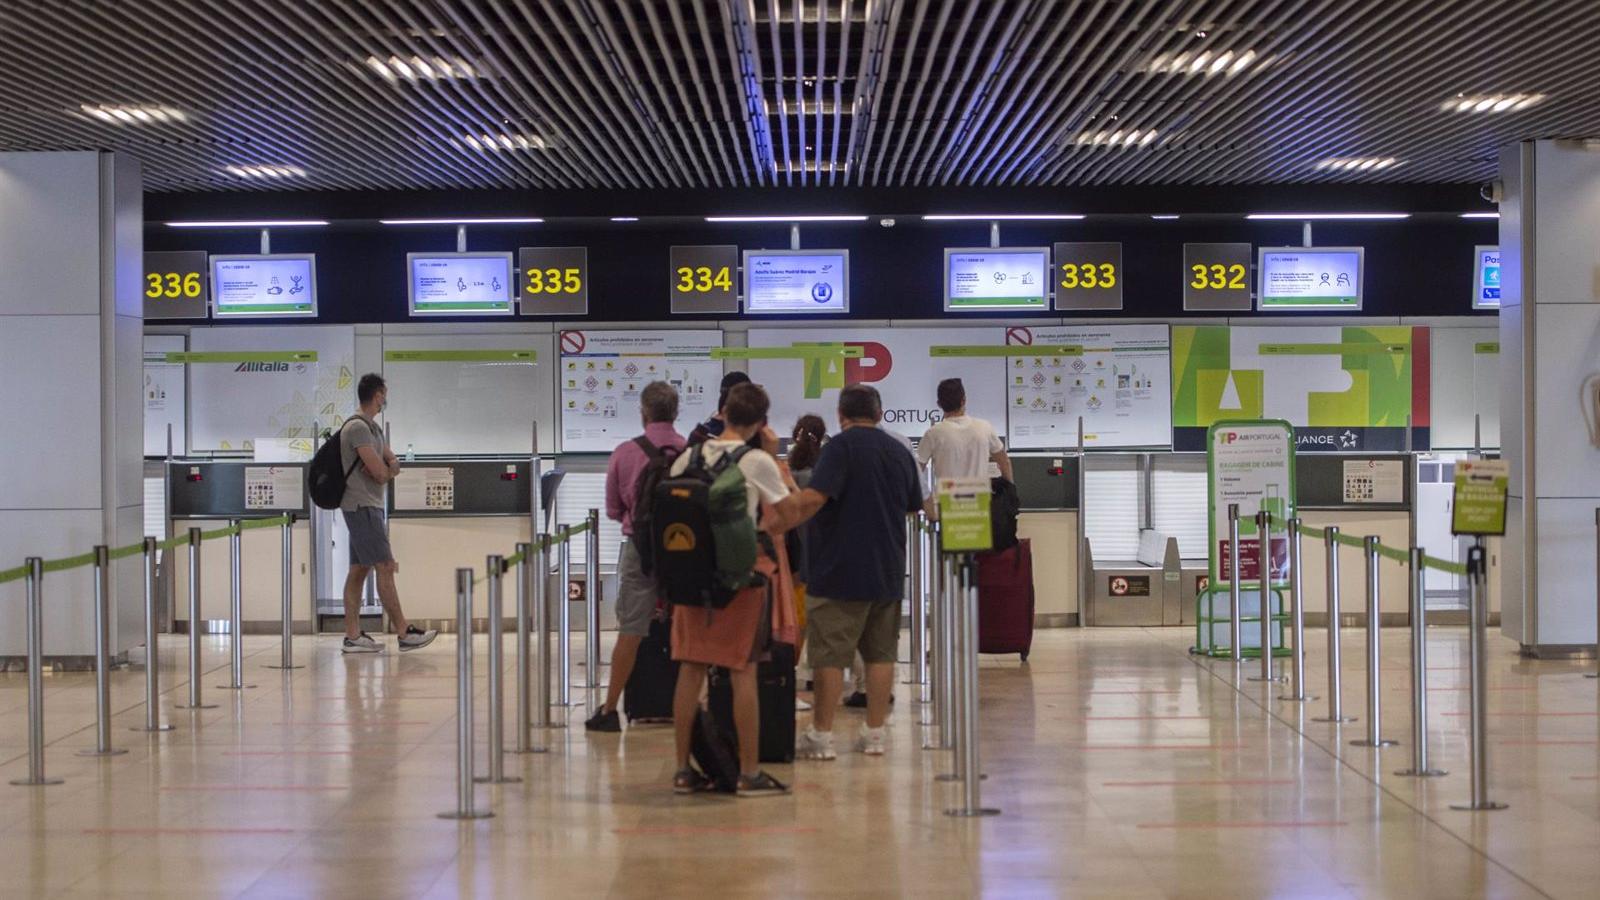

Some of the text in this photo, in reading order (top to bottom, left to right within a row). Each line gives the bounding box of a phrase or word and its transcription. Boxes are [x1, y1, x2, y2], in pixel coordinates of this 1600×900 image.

[146, 273, 200, 298] 336
[527, 269, 582, 294] 335
[677, 267, 732, 292] 334
[1062, 264, 1115, 288] 333
[1191, 265, 1245, 290] 332
[792, 342, 892, 398] TAP
